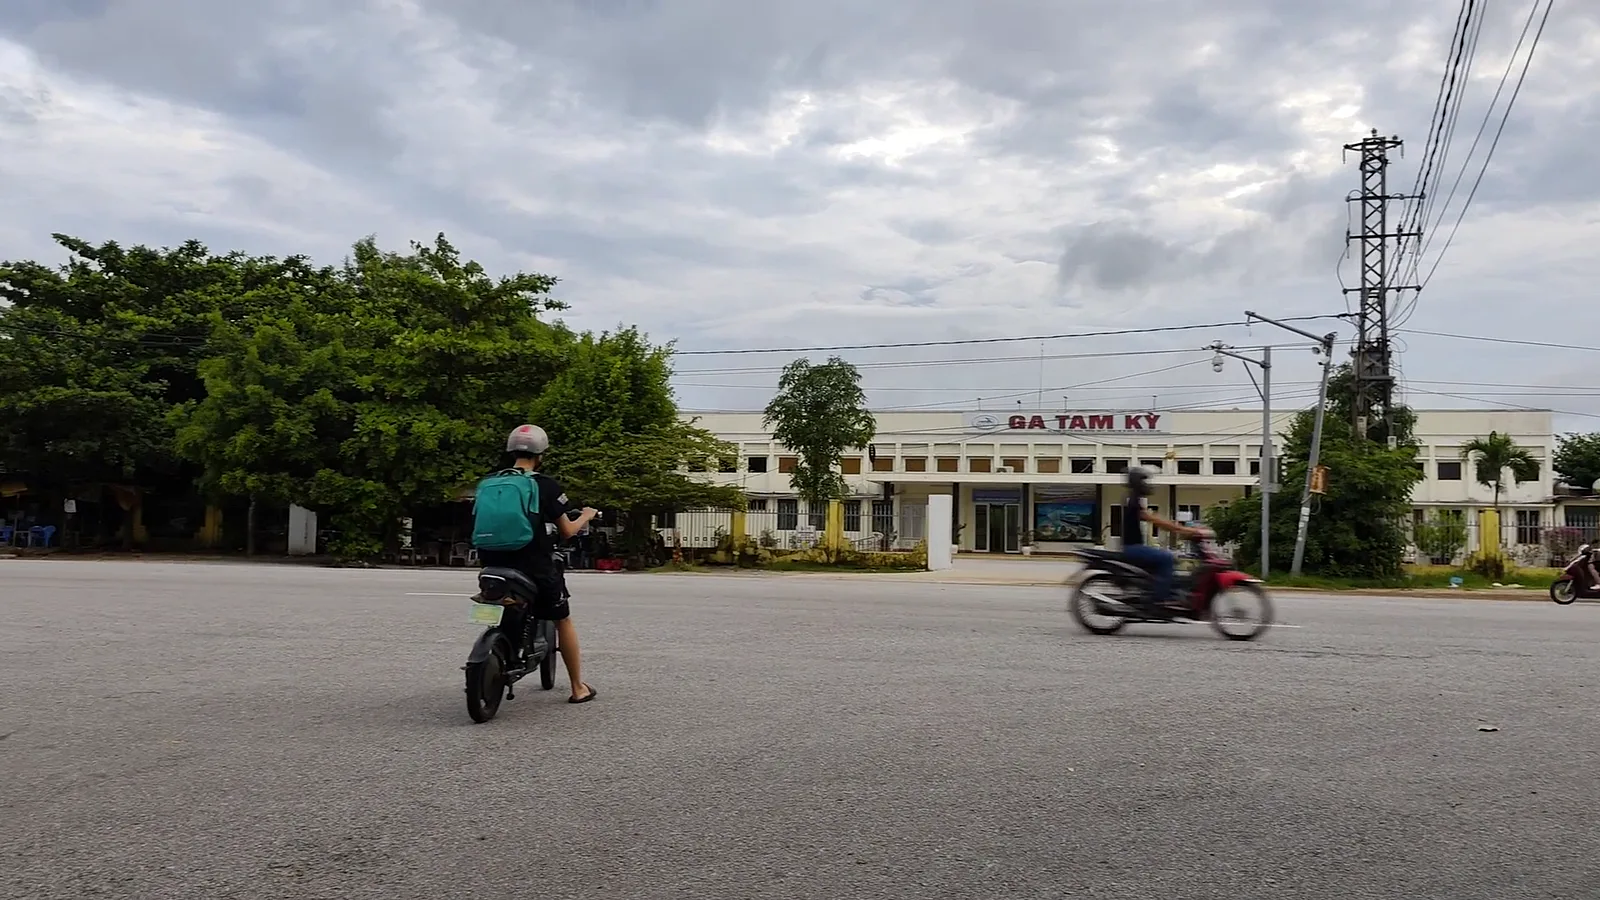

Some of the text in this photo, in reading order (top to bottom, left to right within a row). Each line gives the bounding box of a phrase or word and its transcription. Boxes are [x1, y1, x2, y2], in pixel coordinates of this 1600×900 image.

[1008, 411, 1161, 430] GA TAM KỲ
